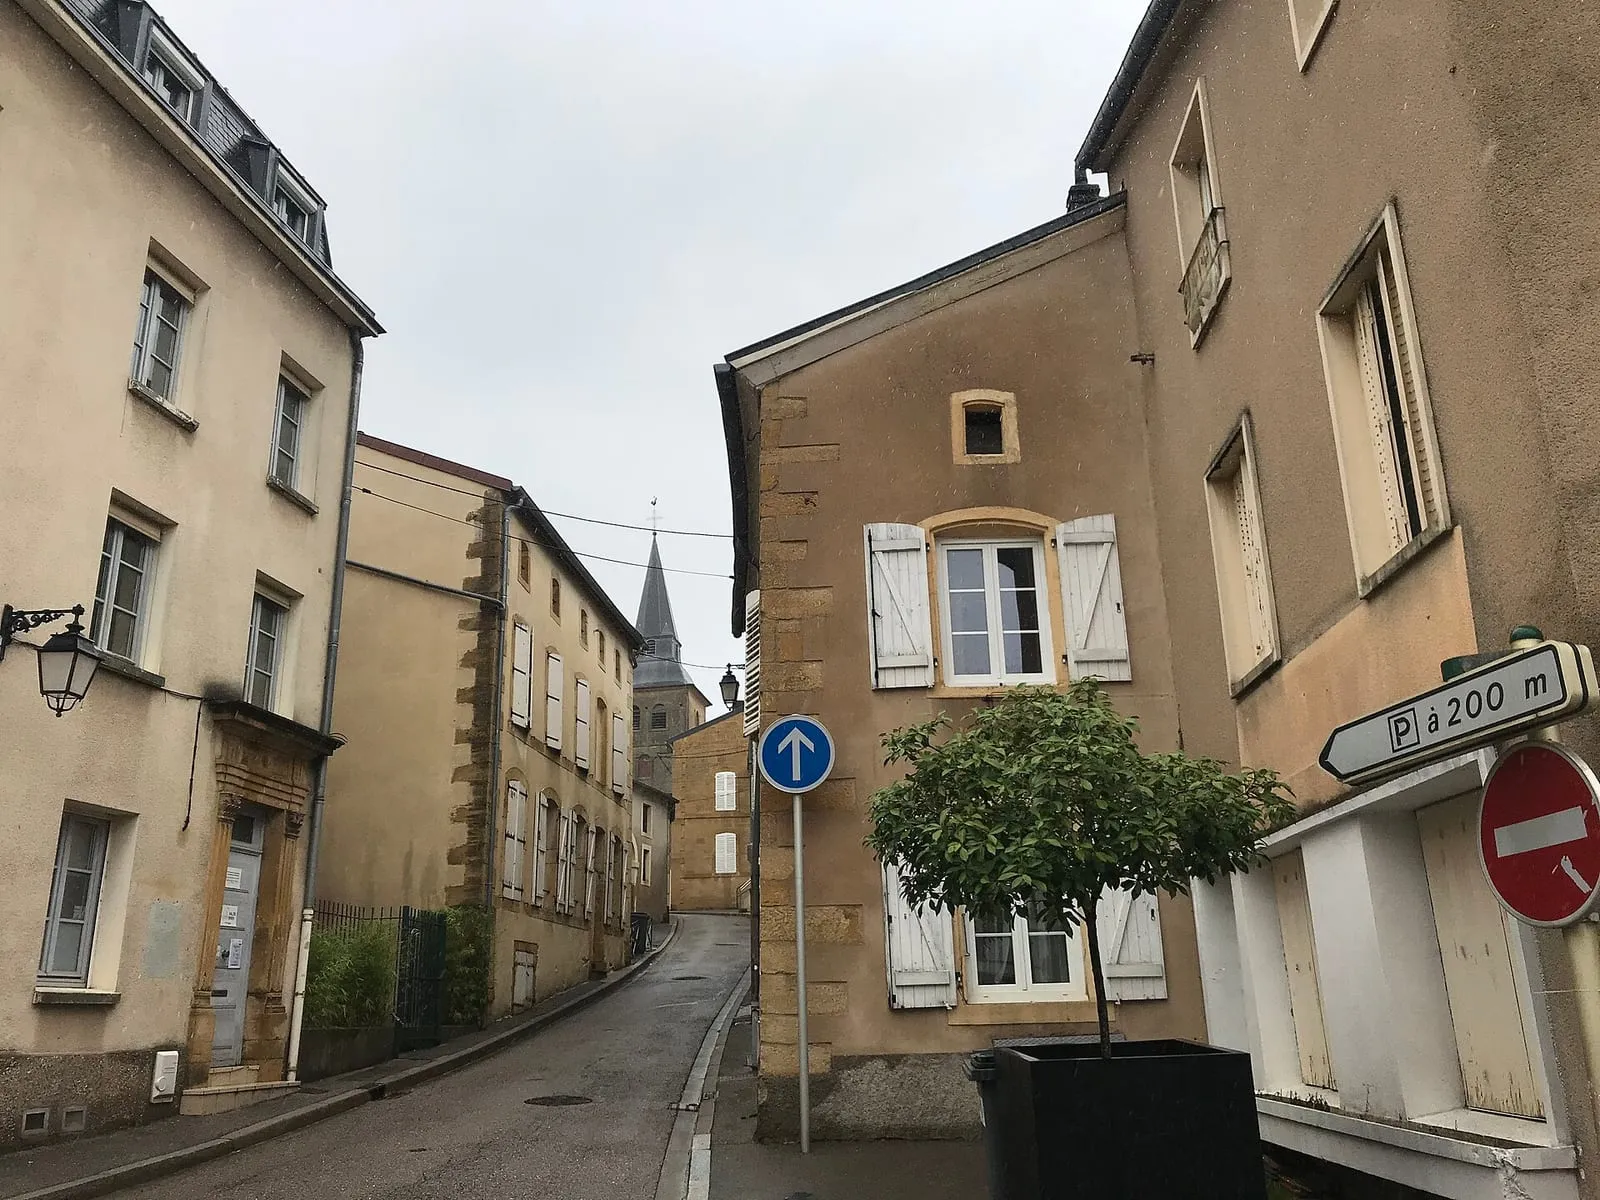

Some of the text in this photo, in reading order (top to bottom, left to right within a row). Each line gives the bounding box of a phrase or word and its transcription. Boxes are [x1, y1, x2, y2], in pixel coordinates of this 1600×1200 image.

[1393, 673, 1547, 746] P à 200 m
